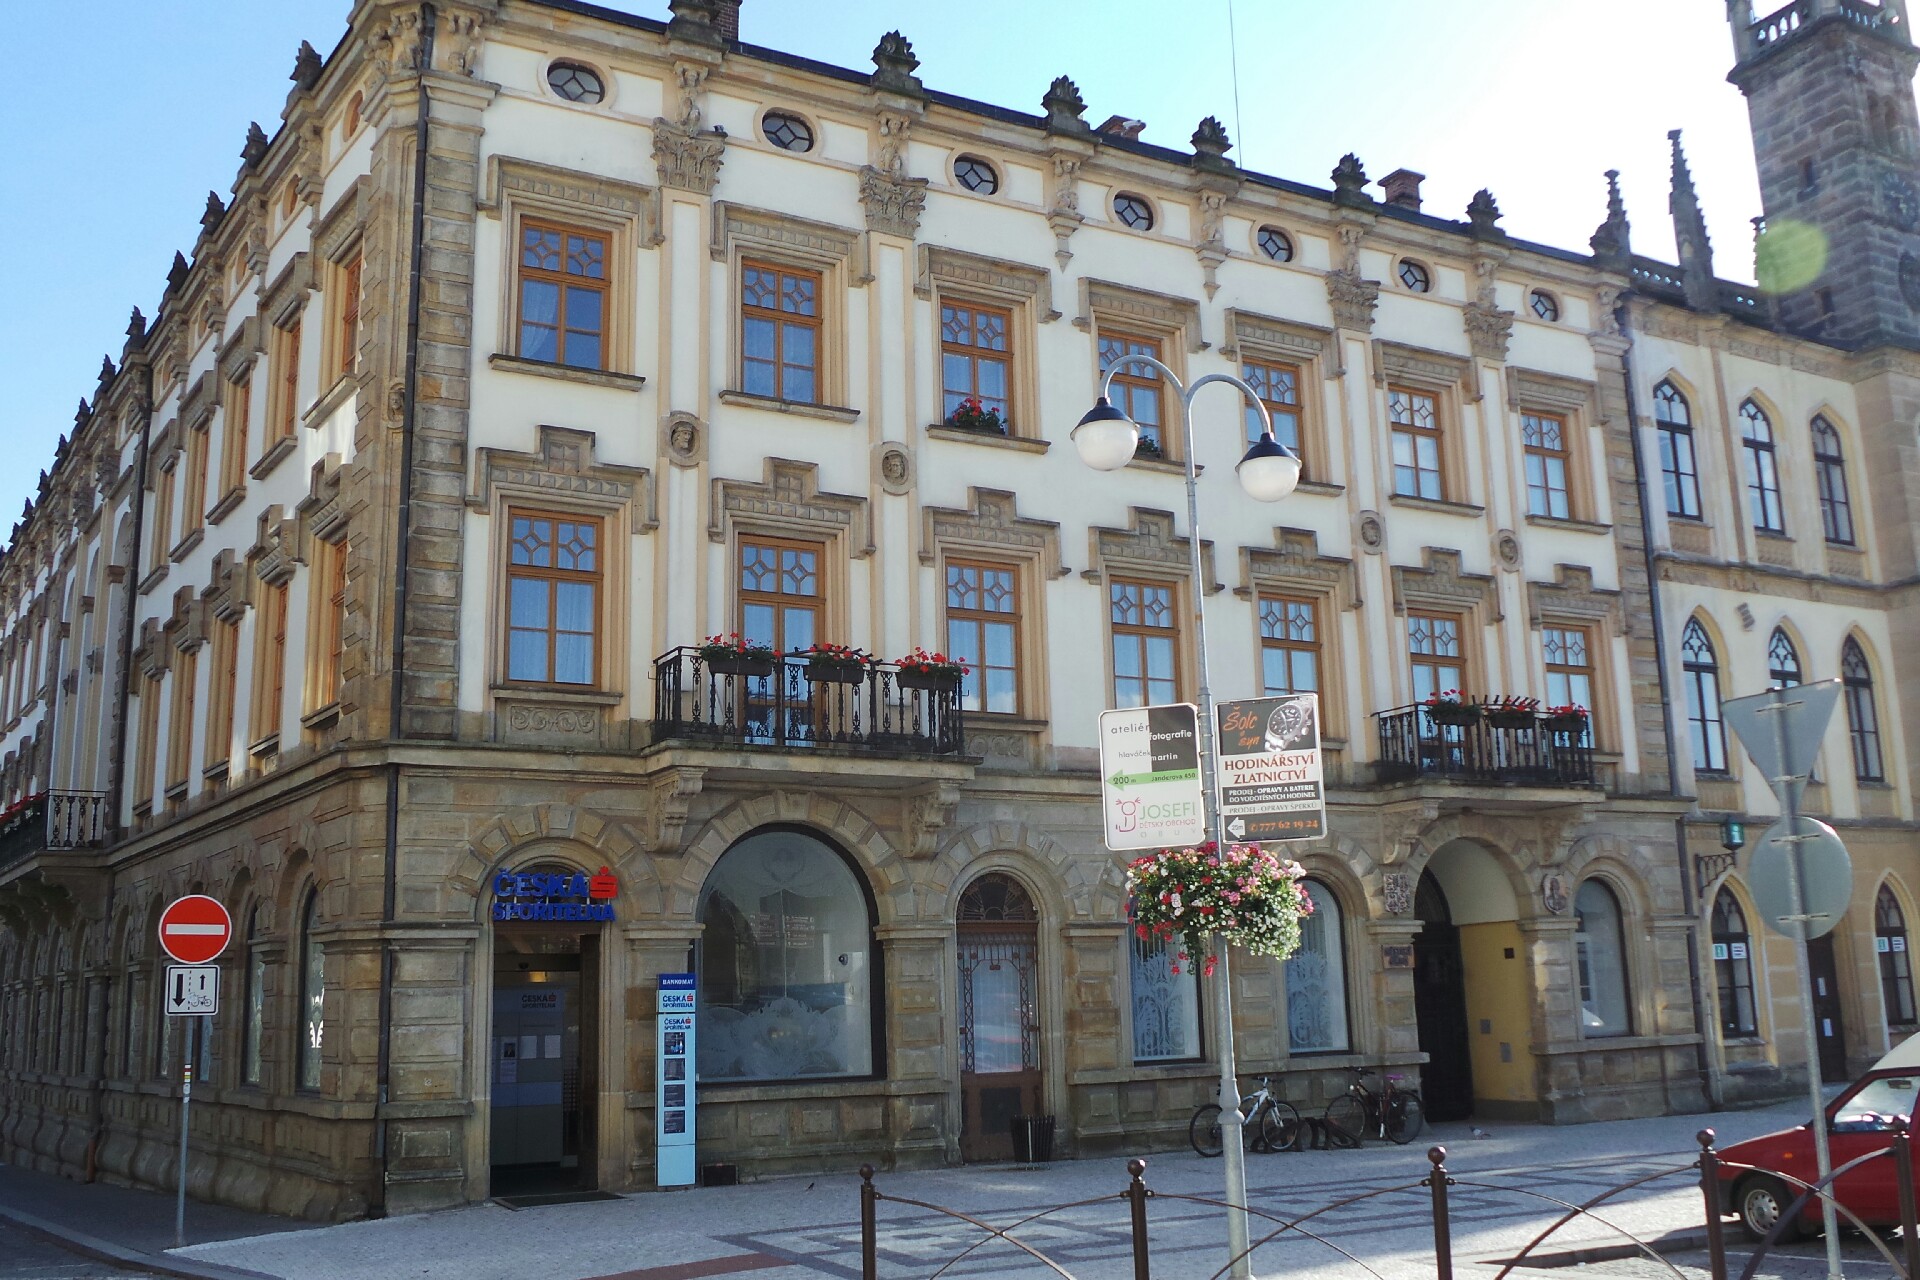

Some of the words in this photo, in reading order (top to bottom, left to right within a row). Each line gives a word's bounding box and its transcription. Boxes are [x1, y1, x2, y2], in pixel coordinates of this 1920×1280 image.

[1223, 706, 1258, 731] Šolc
[1111, 723, 1150, 734] ateliér
[1150, 730, 1192, 741] fotografie
[1238, 736, 1261, 750] syn
[1118, 750, 1151, 758] hlaváček
[1151, 752, 1178, 761] martin
[1224, 751, 1314, 771] HODINÁŘSTVÍ
[1113, 776, 1130, 785] 200
[1233, 766, 1307, 784] ZLATNICTVÍ
[1257, 786, 1283, 794] OPRAVY
[1286, 791, 1316, 799] HODINEK
[1139, 802, 1196, 820] JOSEFI
[1229, 806, 1256, 814] PRODEJ
[1260, 804, 1289, 812] OPRAVY
[1165, 819, 1196, 827] OBCHOD
[1259, 822, 1276, 832] 777
[1278, 820, 1291, 829] 62
[1293, 820, 1303, 829] 19
[1305, 819, 1319, 828] 24
[493, 868, 590, 897] ČESKÁ
[493, 899, 616, 921] SPOŘITELNA
